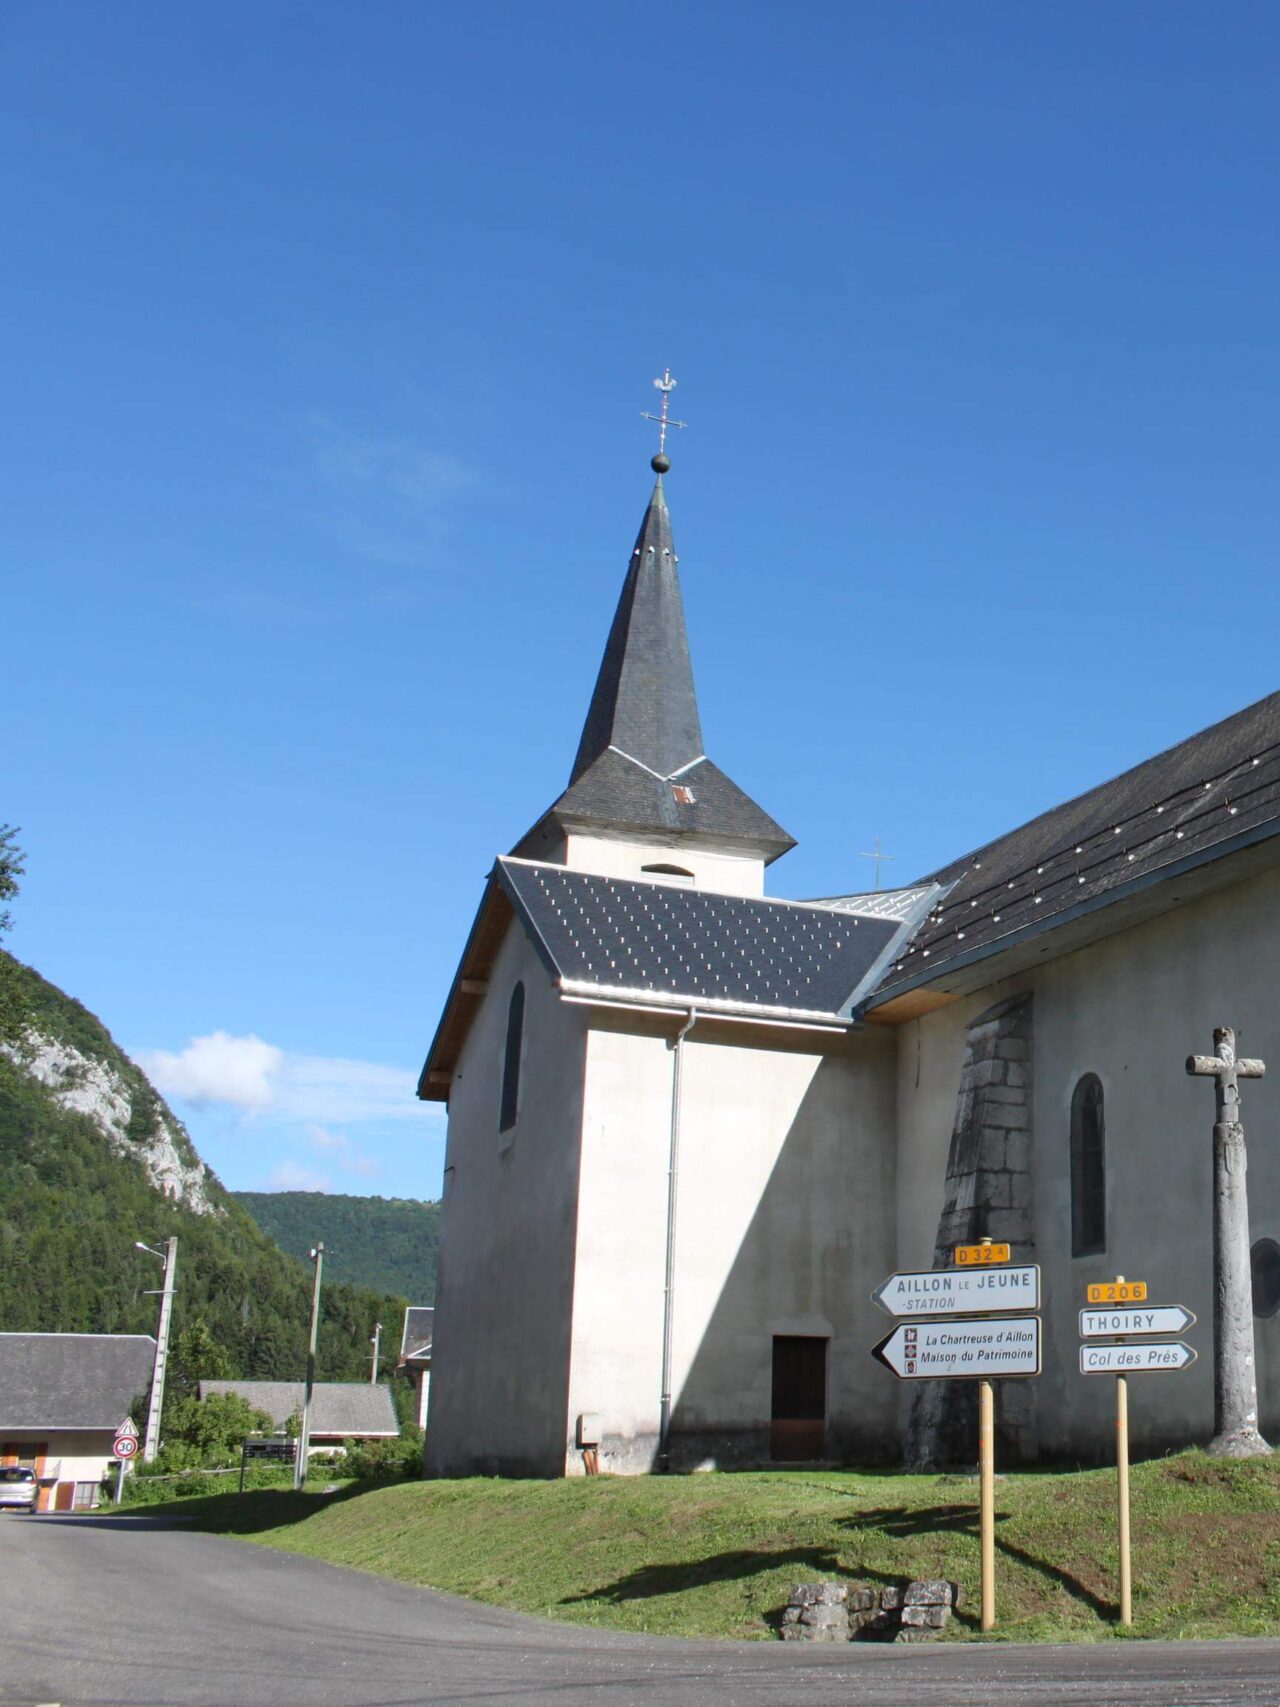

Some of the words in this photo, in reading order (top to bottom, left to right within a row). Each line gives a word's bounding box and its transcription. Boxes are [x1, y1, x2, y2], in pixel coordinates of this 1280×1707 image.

[959, 1249, 968, 1263] D
[973, 1247, 992, 1261] 32
[897, 1278, 952, 1294] AILLON
[958, 1280, 970, 1290] LE
[976, 1273, 1031, 1289] JEUNE
[1091, 1287, 1101, 1301] D
[1106, 1285, 1142, 1300] 206
[1087, 1314, 1155, 1330] THOIRY
[925, 1335, 938, 1346] La
[940, 1332, 994, 1346] Chartreuse
[996, 1331, 1034, 1343] d'Aillon
[920, 1351, 957, 1363] Maison
[961, 1350, 974, 1361] du
[977, 1348, 1033, 1361] Patrimoine
[1088, 1352, 1112, 1367] Col
[1117, 1351, 1142, 1366] des
[1147, 1349, 1179, 1364] Prés
[119, 1442, 133, 1452] 30
